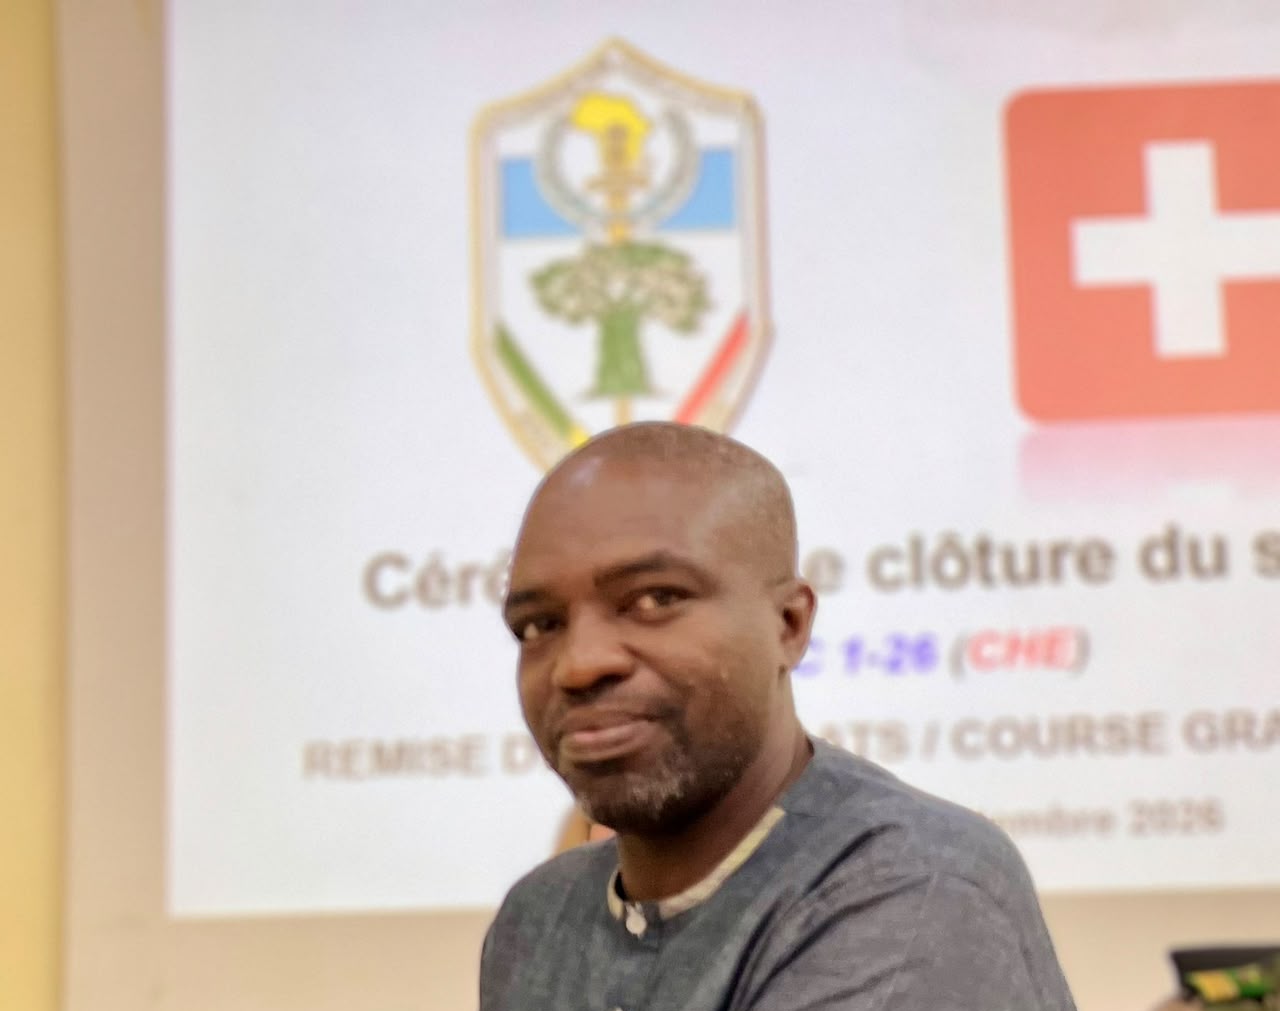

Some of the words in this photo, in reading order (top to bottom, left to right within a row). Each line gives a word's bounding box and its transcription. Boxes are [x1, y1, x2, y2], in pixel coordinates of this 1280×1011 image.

[363, 550, 509, 611] Céré
[803, 546, 844, 595] e
[866, 531, 1115, 593] clôture
[1138, 521, 1229, 583] du
[1251, 532, 1280, 578] s
[303, 735, 487, 780] REMISE
[502, 733, 536, 776] D
[951, 710, 1167, 761] COURSE
[1182, 706, 1280, 754] GRA
